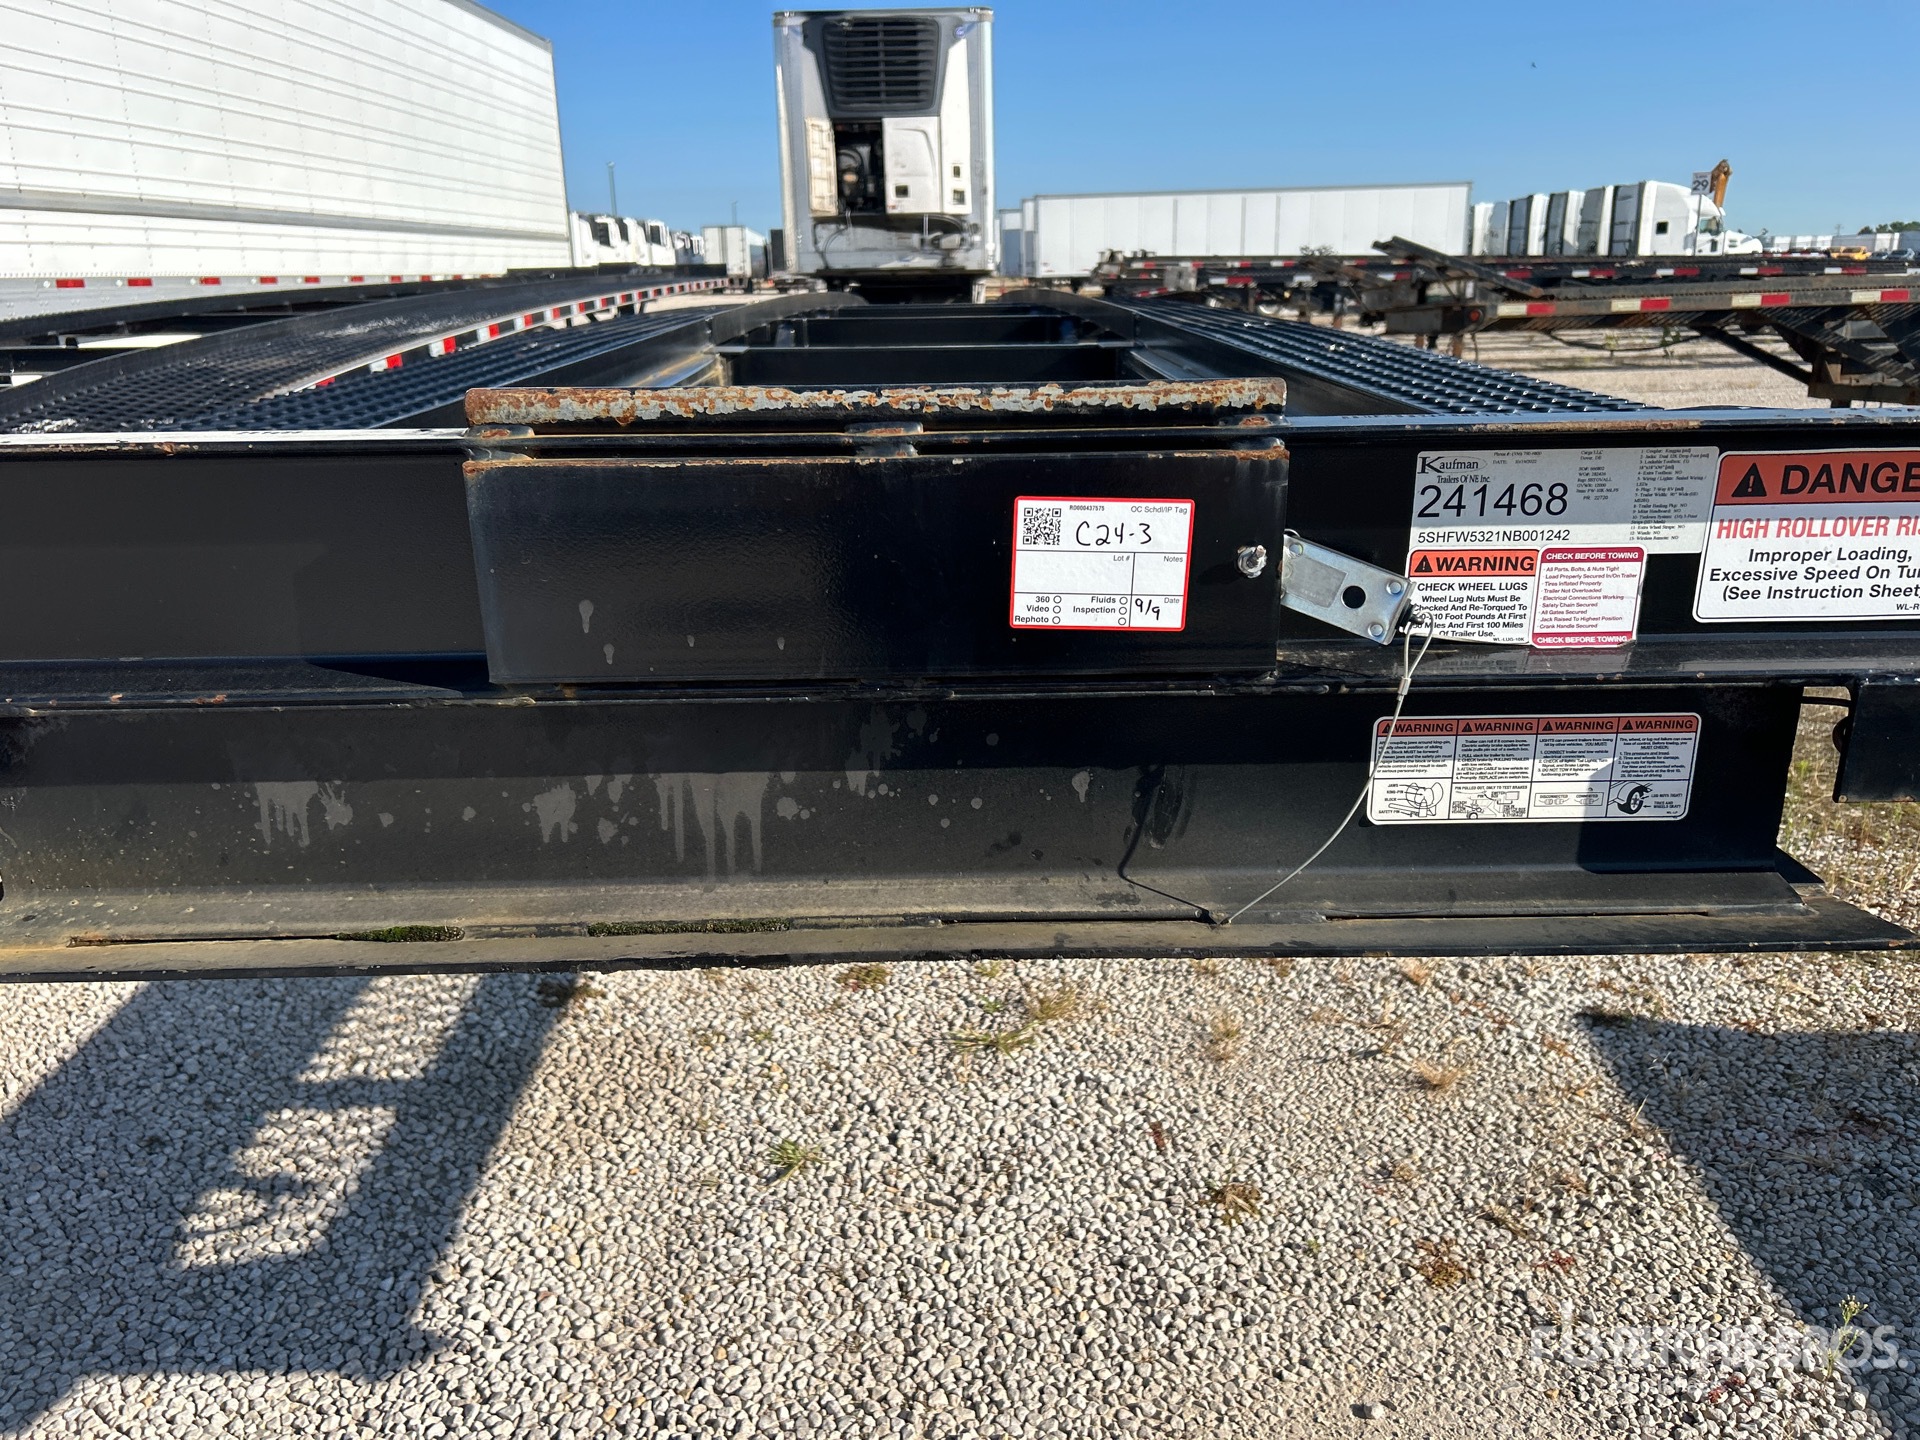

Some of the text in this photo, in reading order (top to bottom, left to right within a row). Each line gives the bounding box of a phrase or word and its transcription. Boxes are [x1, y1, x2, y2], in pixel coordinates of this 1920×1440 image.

[1692, 179, 1709, 190] 29
[1417, 457, 1478, 474] Kaufman
[1417, 483, 1568, 517] 241468
[1174, 507, 1187, 515] Tag
[1076, 521, 1152, 546] C24-3
[1717, 516, 1920, 539] HIGH ROLLOVER RI
[1418, 529, 1570, 543] 5SHFW5321NB001242
[1749, 547, 1912, 564] Improper Loading,
[1436, 556, 1534, 571] WARNING
[1709, 567, 1798, 582] Excessive
[1804, 566, 1860, 583] Speed
[1866, 566, 1890, 579] On
[1417, 582, 1528, 591] CHECK WHEEL LUGS
[1723, 586, 1761, 601] (See
[1767, 584, 1863, 599] Instruction
[1073, 606, 1116, 614] Inspection
[1134, 598, 1161, 621] 9/9
[1469, 604, 1515, 612] Re-Torqued
[1394, 723, 1454, 732] WARNING
[1474, 722, 1534, 731] WARNING
[1555, 721, 1614, 730] WARNING
[1635, 720, 1693, 729] WARNING
